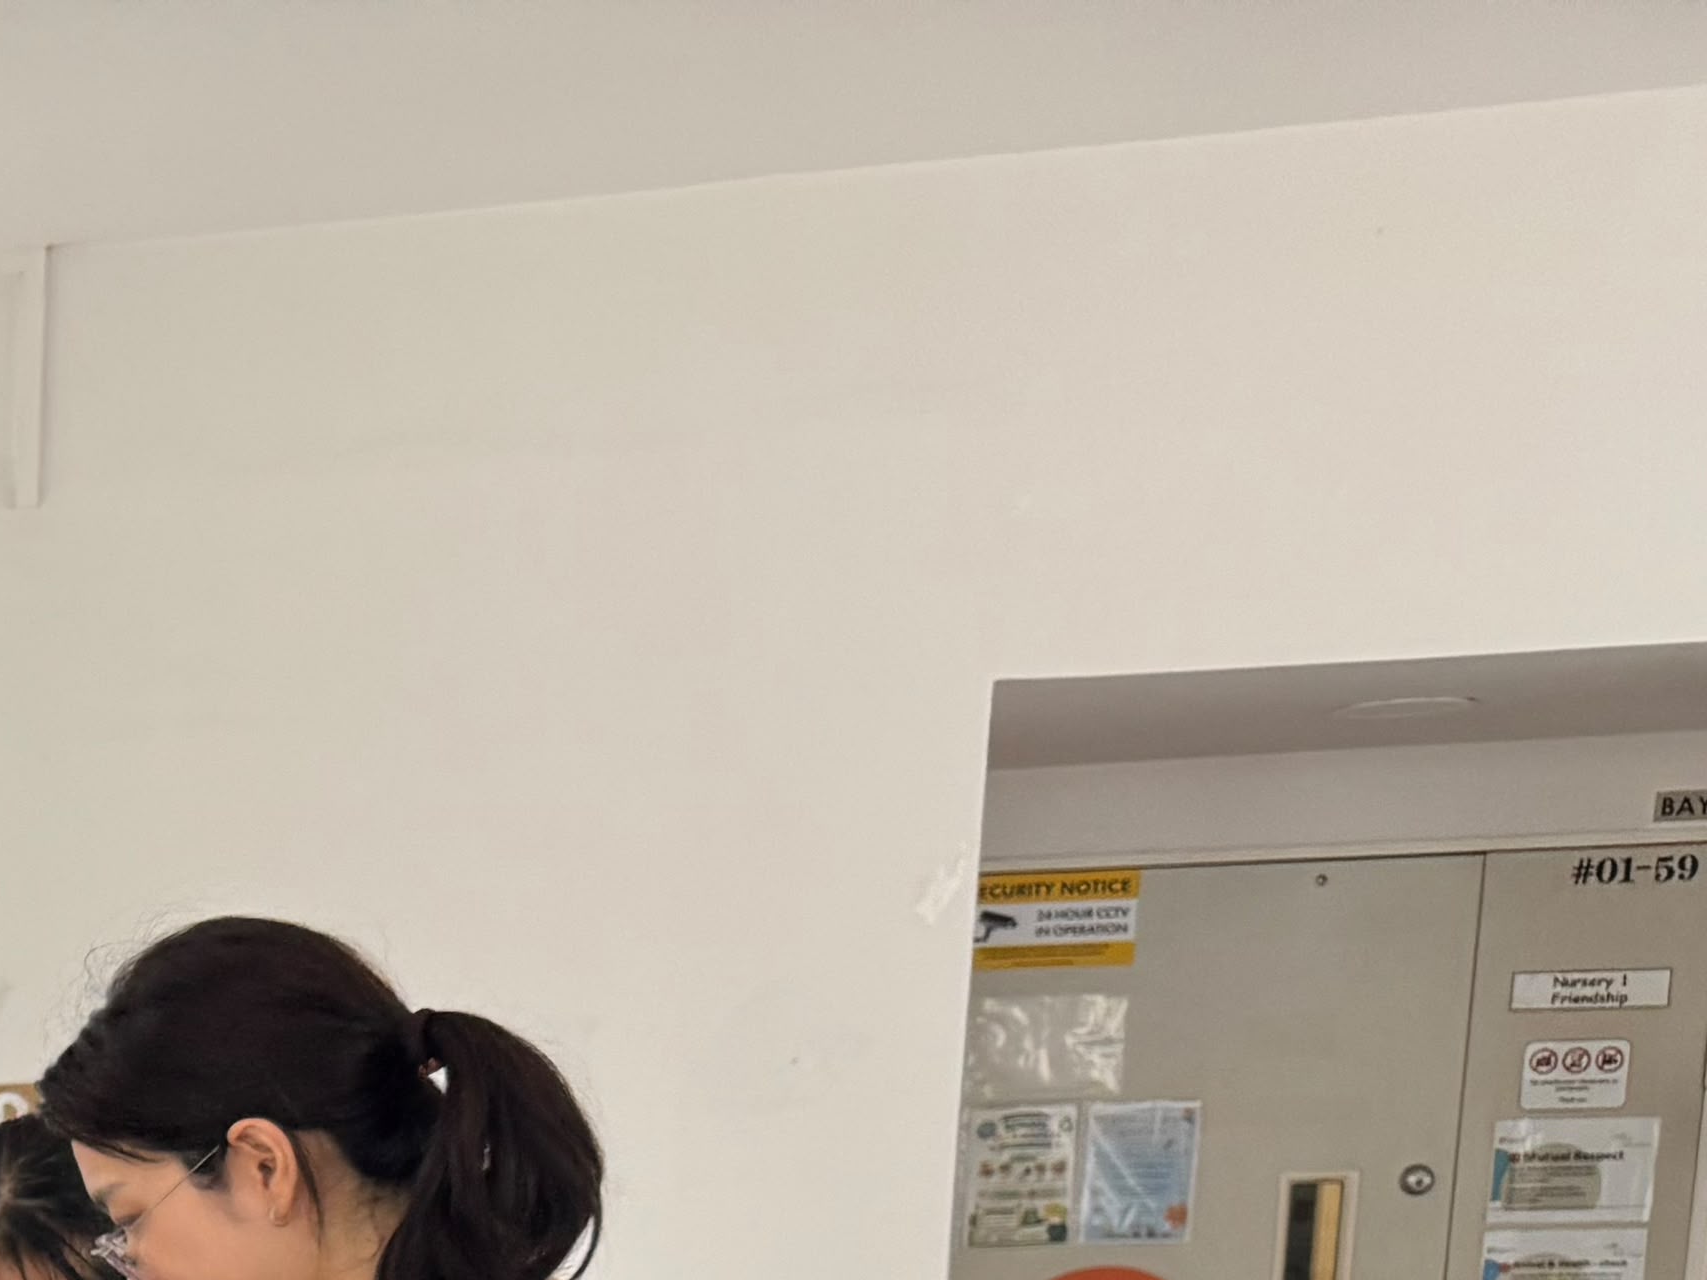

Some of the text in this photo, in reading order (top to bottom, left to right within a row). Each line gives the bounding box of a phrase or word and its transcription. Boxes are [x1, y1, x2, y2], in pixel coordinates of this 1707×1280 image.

[1572, 854, 1699, 885] #01-59
[979, 878, 1133, 899] ECURITY NOTICE
[1553, 975, 1614, 989] Nursery
[1550, 991, 1628, 1008] Friendship
